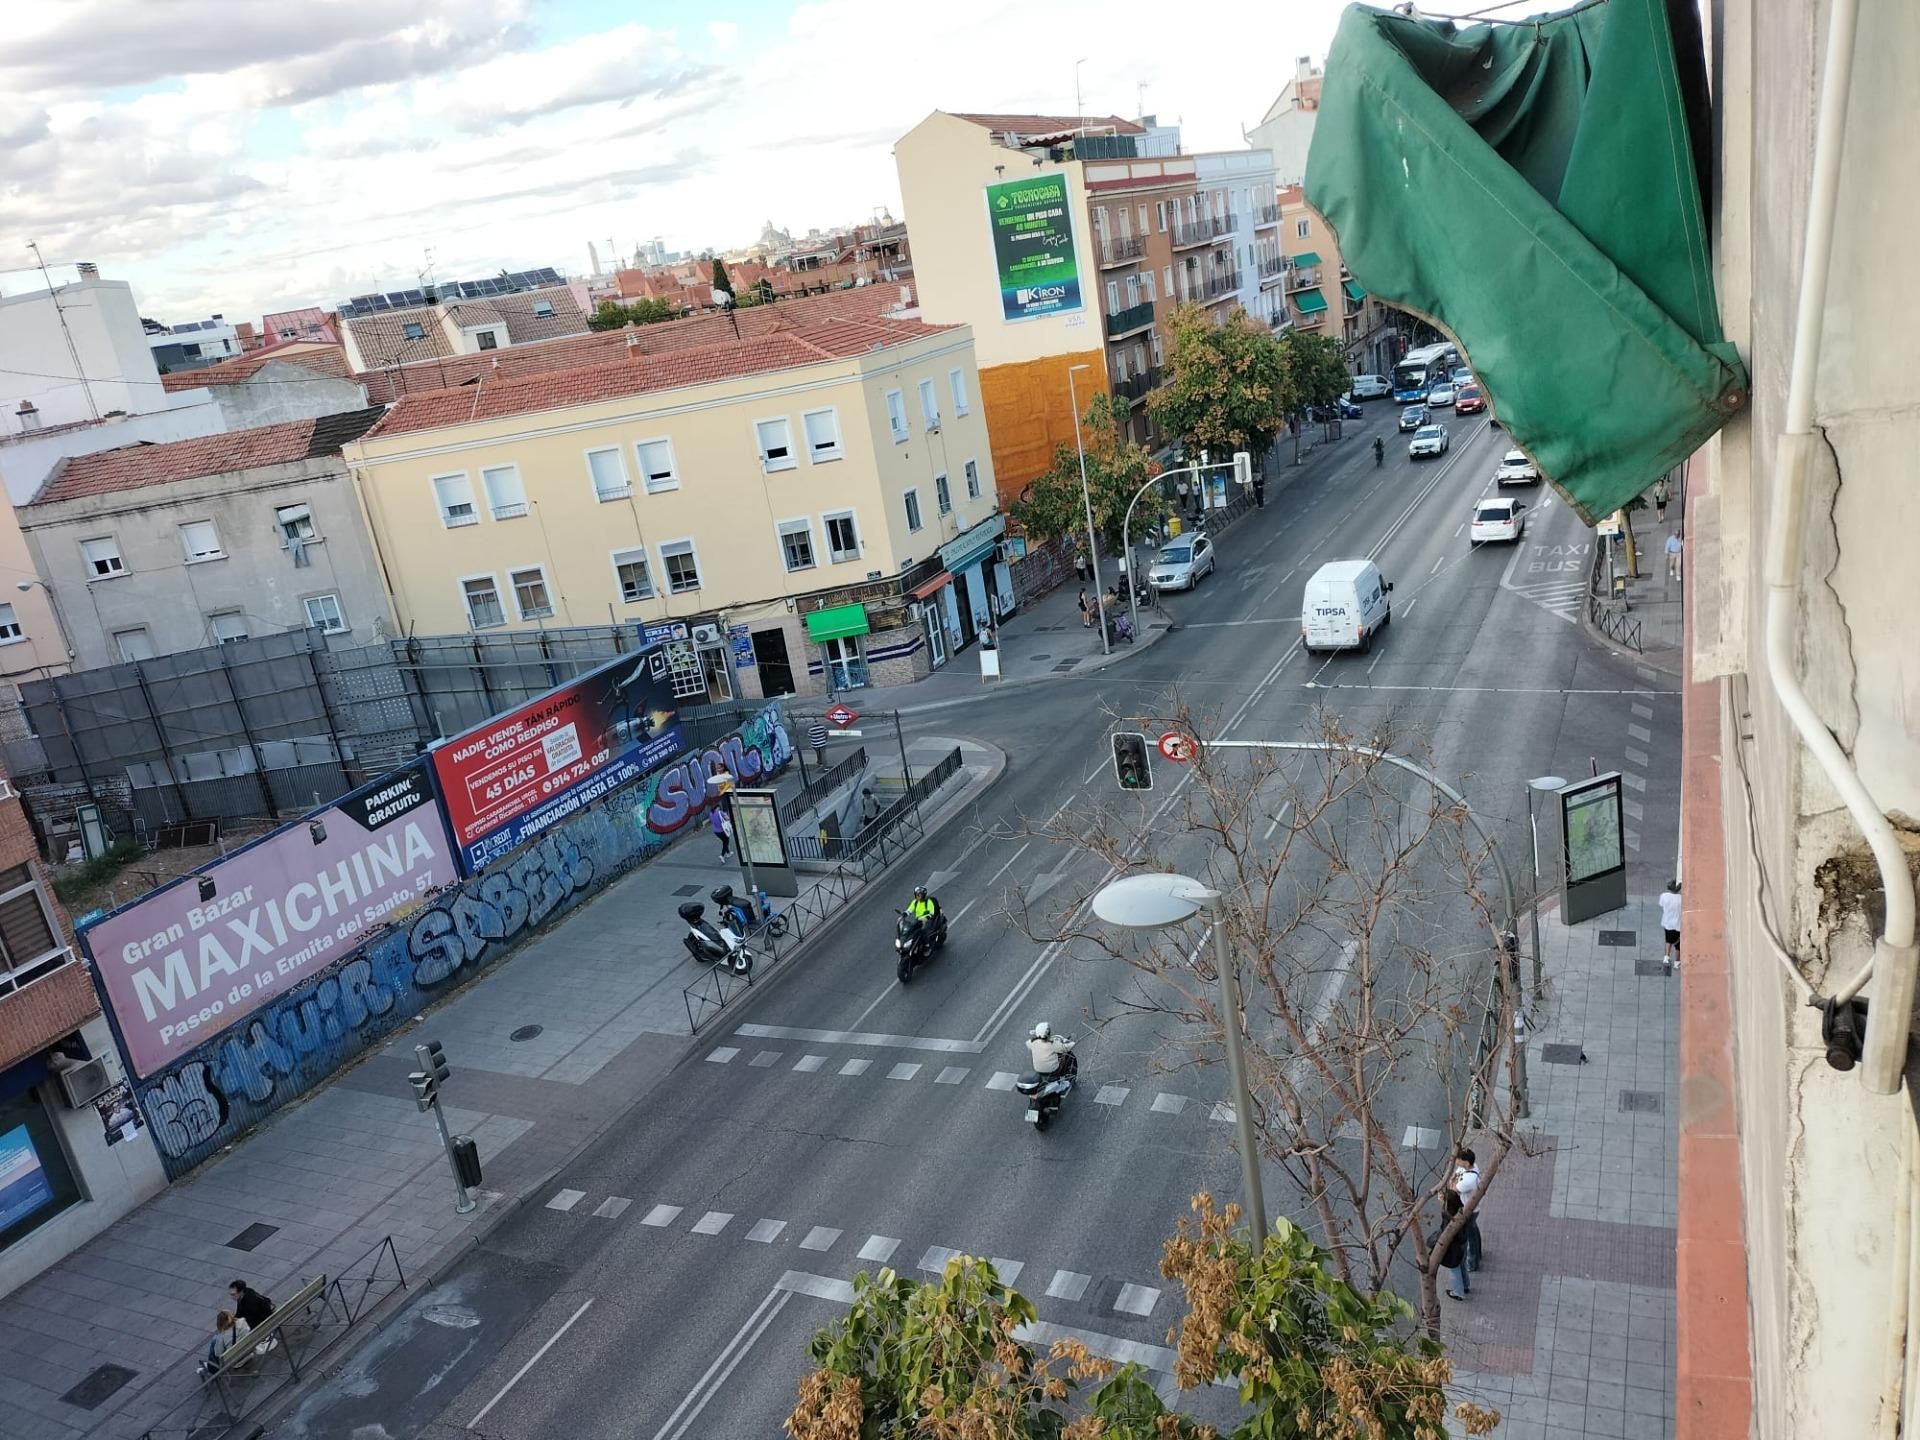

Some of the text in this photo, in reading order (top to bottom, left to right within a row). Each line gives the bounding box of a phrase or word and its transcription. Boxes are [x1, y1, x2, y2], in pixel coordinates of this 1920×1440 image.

[1011, 185, 1060, 204] TECNOCASA
[1528, 560, 1581, 573] BUS
[1533, 544, 1589, 557] TAXI
[1315, 607, 1346, 616] TIPSA
[452, 739, 487, 763] NADIE
[488, 722, 523, 744] VENDE
[546, 694, 580, 717] RÁPIDO
[485, 739, 515, 759] COMO
[517, 716, 559, 743] REDPISO
[469, 747, 543, 789] VENDEMOS SU PISO EN
[486, 765, 535, 799] 45 DÍAS
[552, 772, 571, 789] 914
[571, 761, 590, 778] 724
[591, 749, 610, 766] 087
[368, 792, 421, 826] GRATUITO
[520, 796, 580, 839] FINANCIACIÓN
[581, 782, 607, 804] HASTA
[606, 776, 618, 789] EL
[617, 762, 639, 782] 100%
[475, 817, 498, 834] General
[122, 885, 253, 964] Gran Bazar
[131, 821, 436, 1023] MAXICHINA
[160, 1000, 224, 1046] Paseo
[227, 983, 252, 1005] de
[254, 970, 274, 989] la
[276, 934, 334, 977] Ermita
[336, 913, 363, 941] del
[364, 888, 415, 922] Santo,
[416, 871, 433, 891] 57
